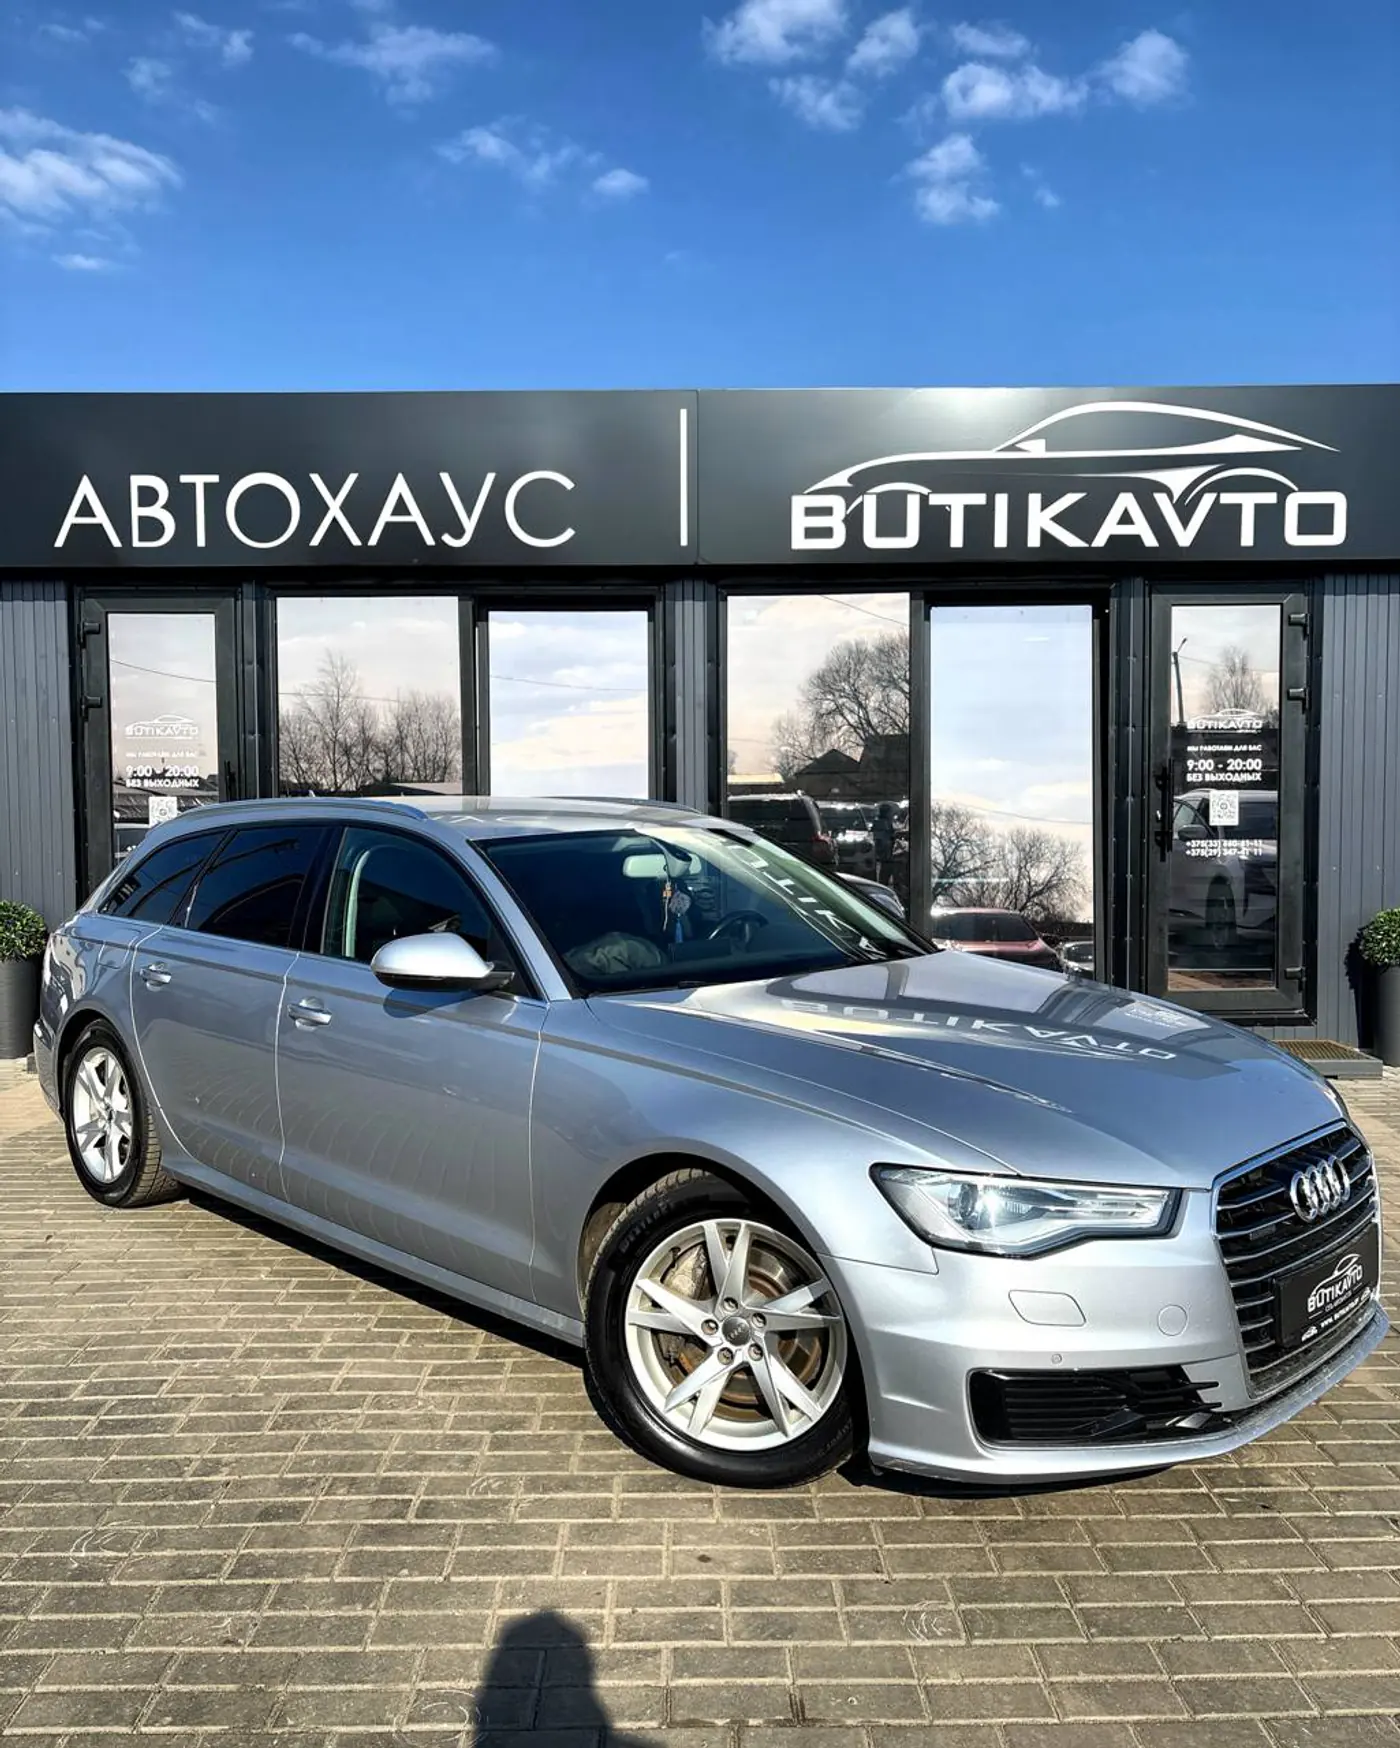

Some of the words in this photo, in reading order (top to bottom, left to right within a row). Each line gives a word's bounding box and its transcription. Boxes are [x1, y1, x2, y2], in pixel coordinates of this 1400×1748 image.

[53, 470, 576, 549] АВТОХАУС
[790, 489, 1348, 551] BUTIKAVTO
[1187, 719, 1262, 730] BUTIKAVTO
[125, 725, 199, 736] BUTIKAVTO
[1187, 759, 1214, 770] 9:00
[1227, 759, 1262, 770] 20:00
[126, 765, 152, 777] 9:00
[165, 765, 199, 776] 20:00
[1187, 773, 1202, 781] БЕЗ
[1205, 772, 1262, 782] ВЫХОДНЫХ
[144, 779, 199, 787] ВЫХОДНЫХ
[1308, 1265, 1363, 1312] BUTIKAVTO
